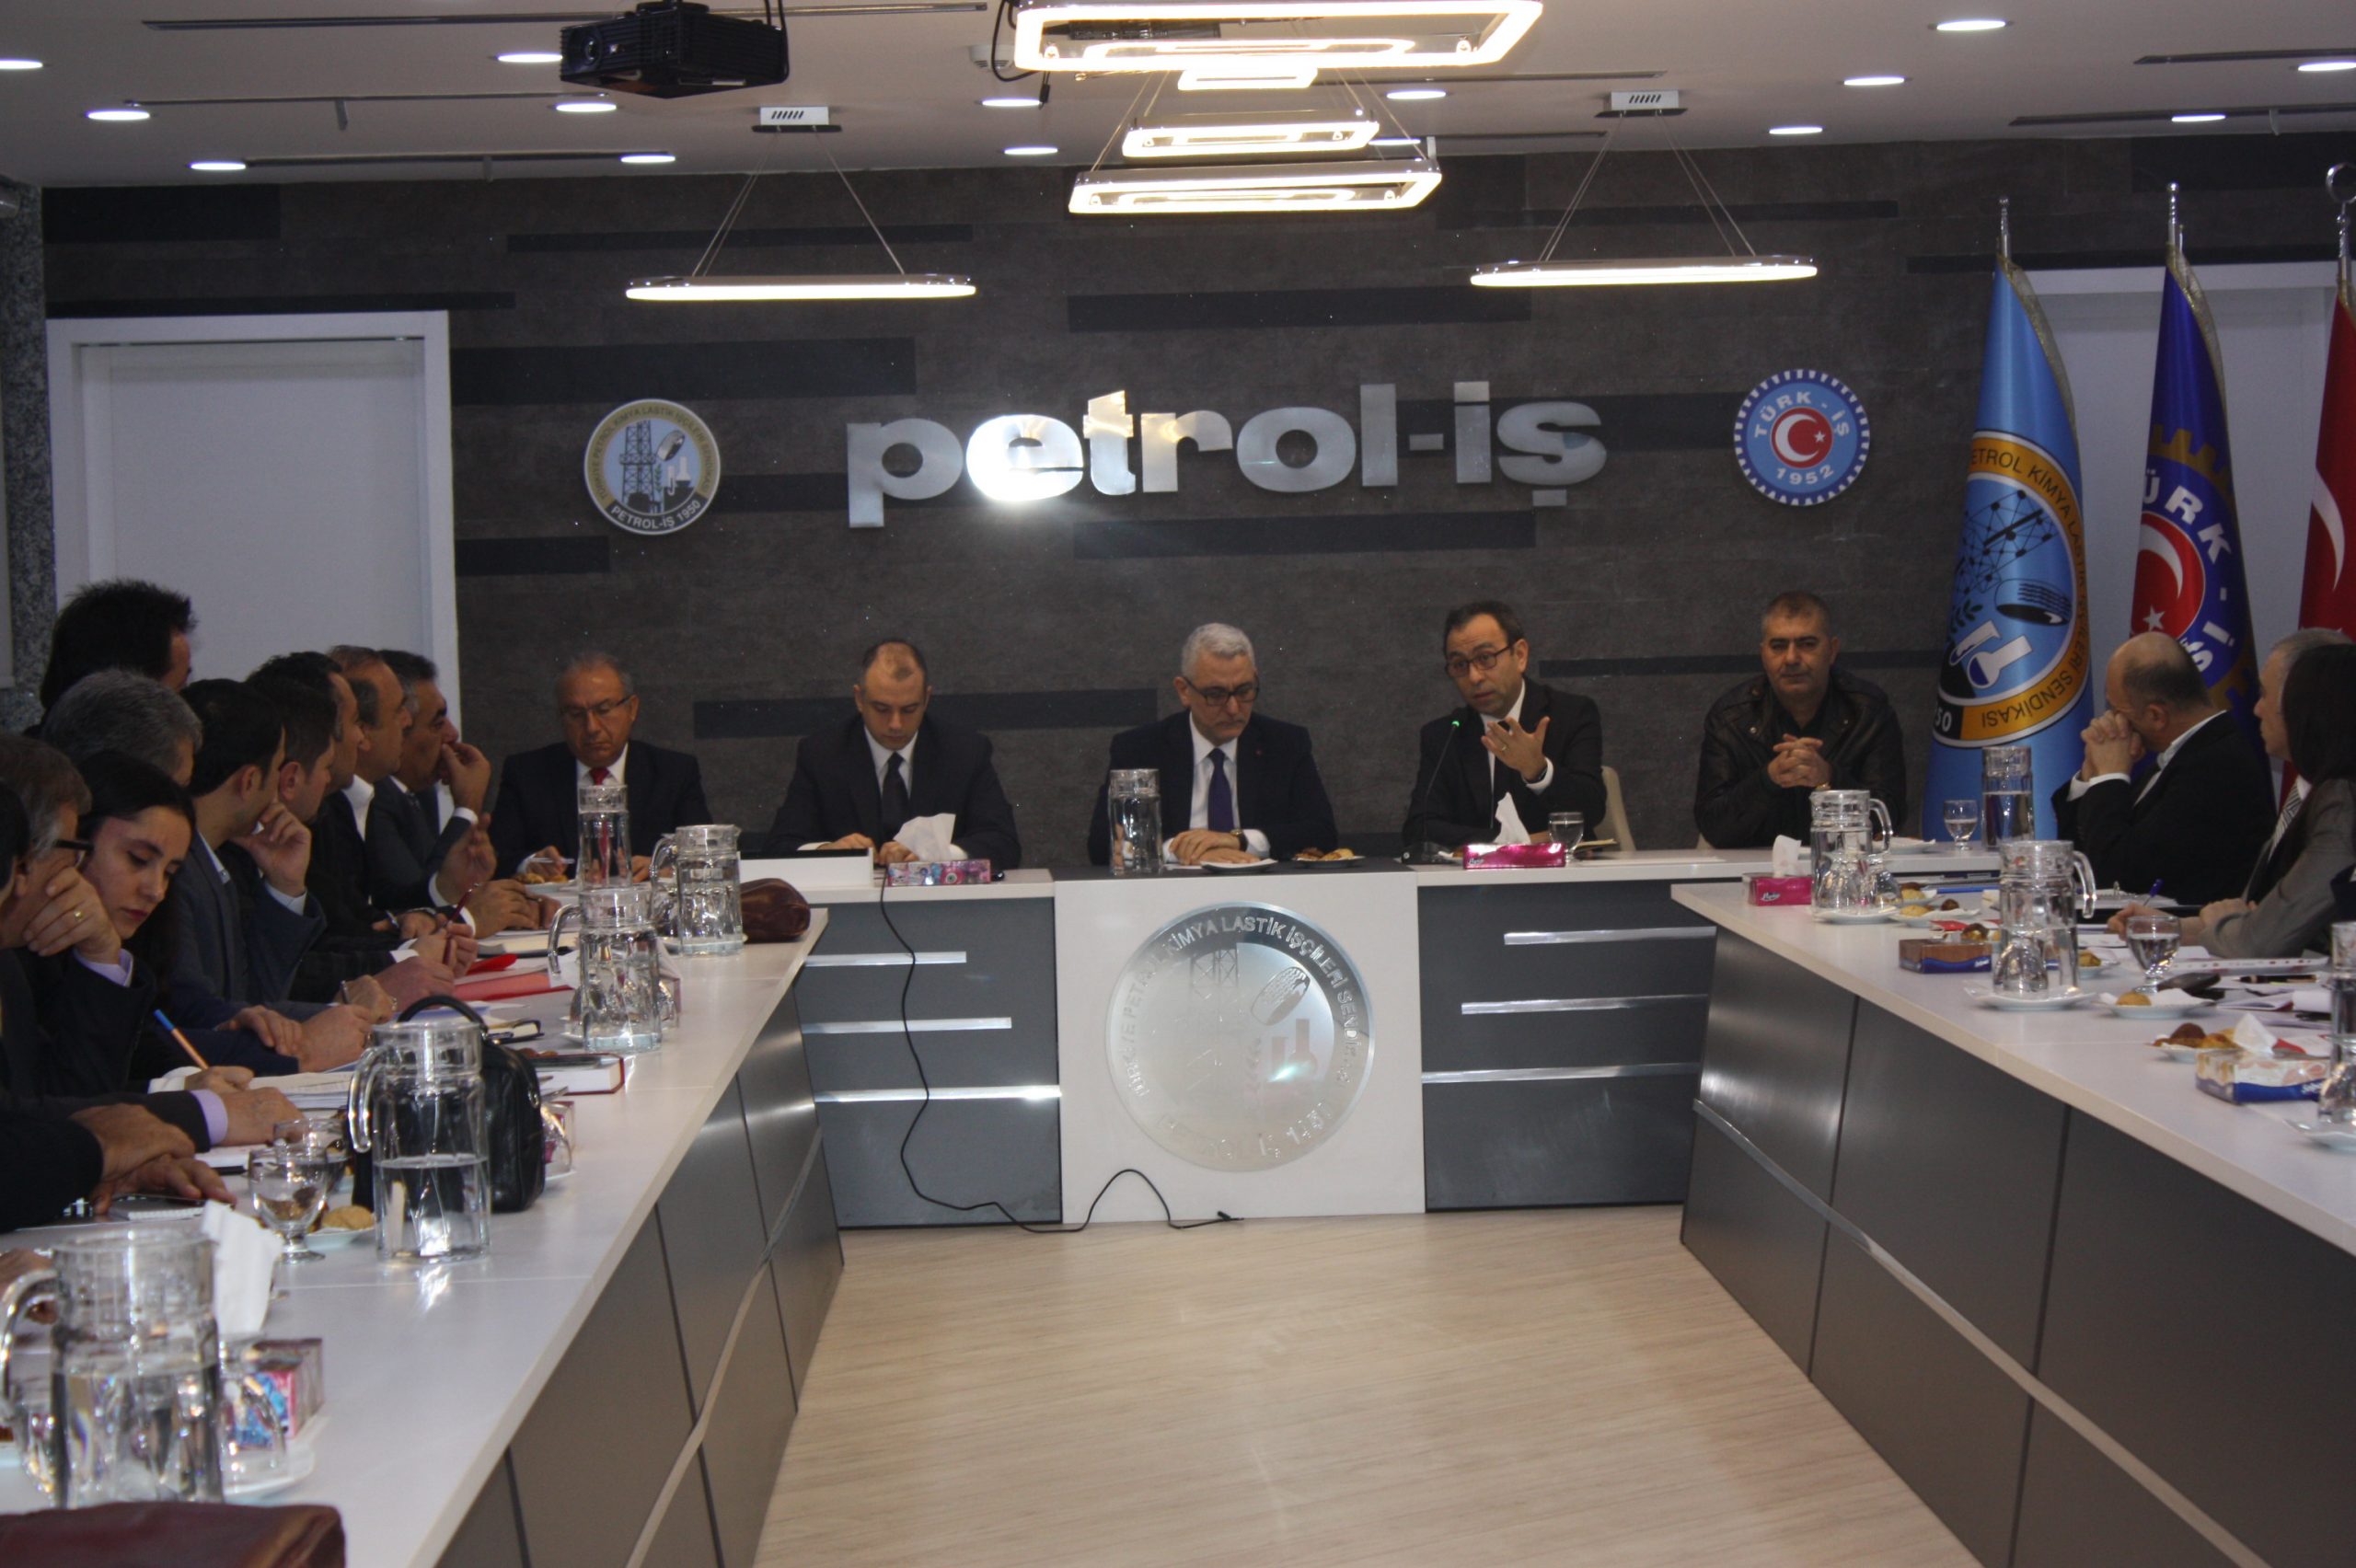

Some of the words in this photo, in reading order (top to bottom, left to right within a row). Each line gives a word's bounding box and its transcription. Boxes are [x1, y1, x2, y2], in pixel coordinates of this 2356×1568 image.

[846, 380, 1608, 528] petrol-iş
[1776, 464, 1834, 485] 1952
[1971, 448, 2022, 474] ETROL
[611, 505, 675, 529] PETROL-İŞ
[676, 500, 701, 522] 1950
[2027, 464, 2071, 520] KİMYA
[2143, 468, 2235, 672] ÜRK-İŞ
[1934, 706, 1952, 732] 50
[1981, 670, 2073, 728] SENDİKASI
[1163, 920, 1218, 955] KİMYA
[1221, 916, 1287, 939] LASTİK
[1285, 926, 1348, 988] İŞÇİLERİ
